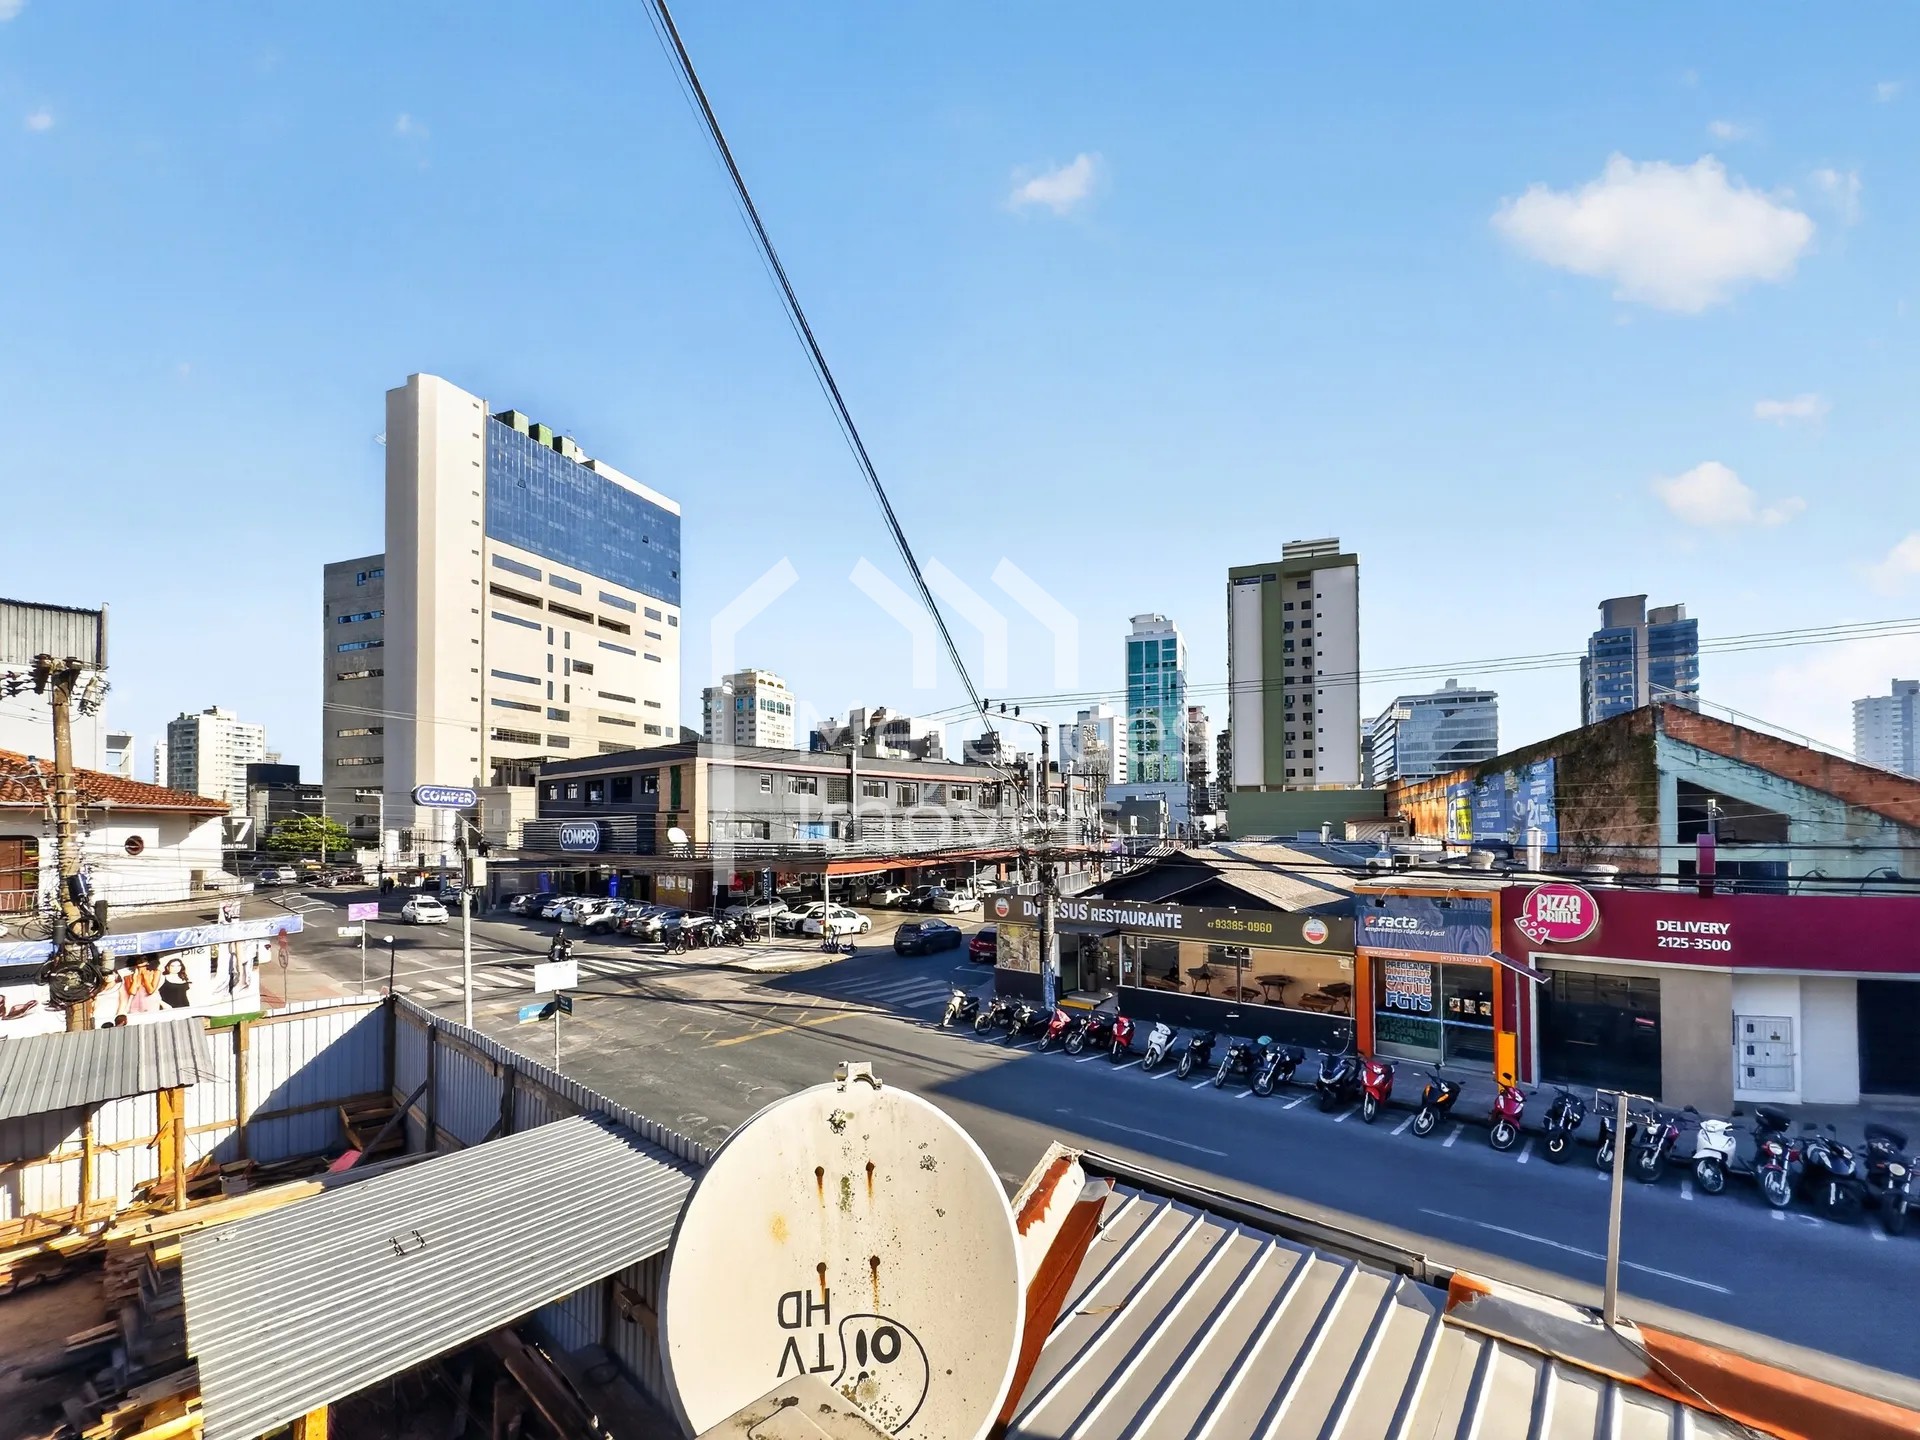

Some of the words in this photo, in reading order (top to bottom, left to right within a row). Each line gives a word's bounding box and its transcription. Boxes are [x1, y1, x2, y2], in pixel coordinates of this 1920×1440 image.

[420, 789, 472, 804] COMPER
[561, 828, 597, 844] COMPER
[1536, 893, 1581, 913] PIZZA
[1052, 902, 1088, 921] ESUS
[1090, 908, 1182, 929] RESTAURANTE
[1378, 916, 1418, 929] facta
[1536, 909, 1581, 924] PRIME
[1215, 919, 1272, 933] 93385-0960
[1656, 920, 1731, 935] DELIVERY
[1657, 936, 1732, 952] 2125-3500
[1385, 960, 1419, 969] PRECISA
[1420, 963, 1431, 971] DE
[1386, 981, 1432, 997] SAQUE
[1386, 990, 1432, 1011] FGTS
[778, 1288, 830, 1329] HD
[777, 1333, 834, 1378] TV
